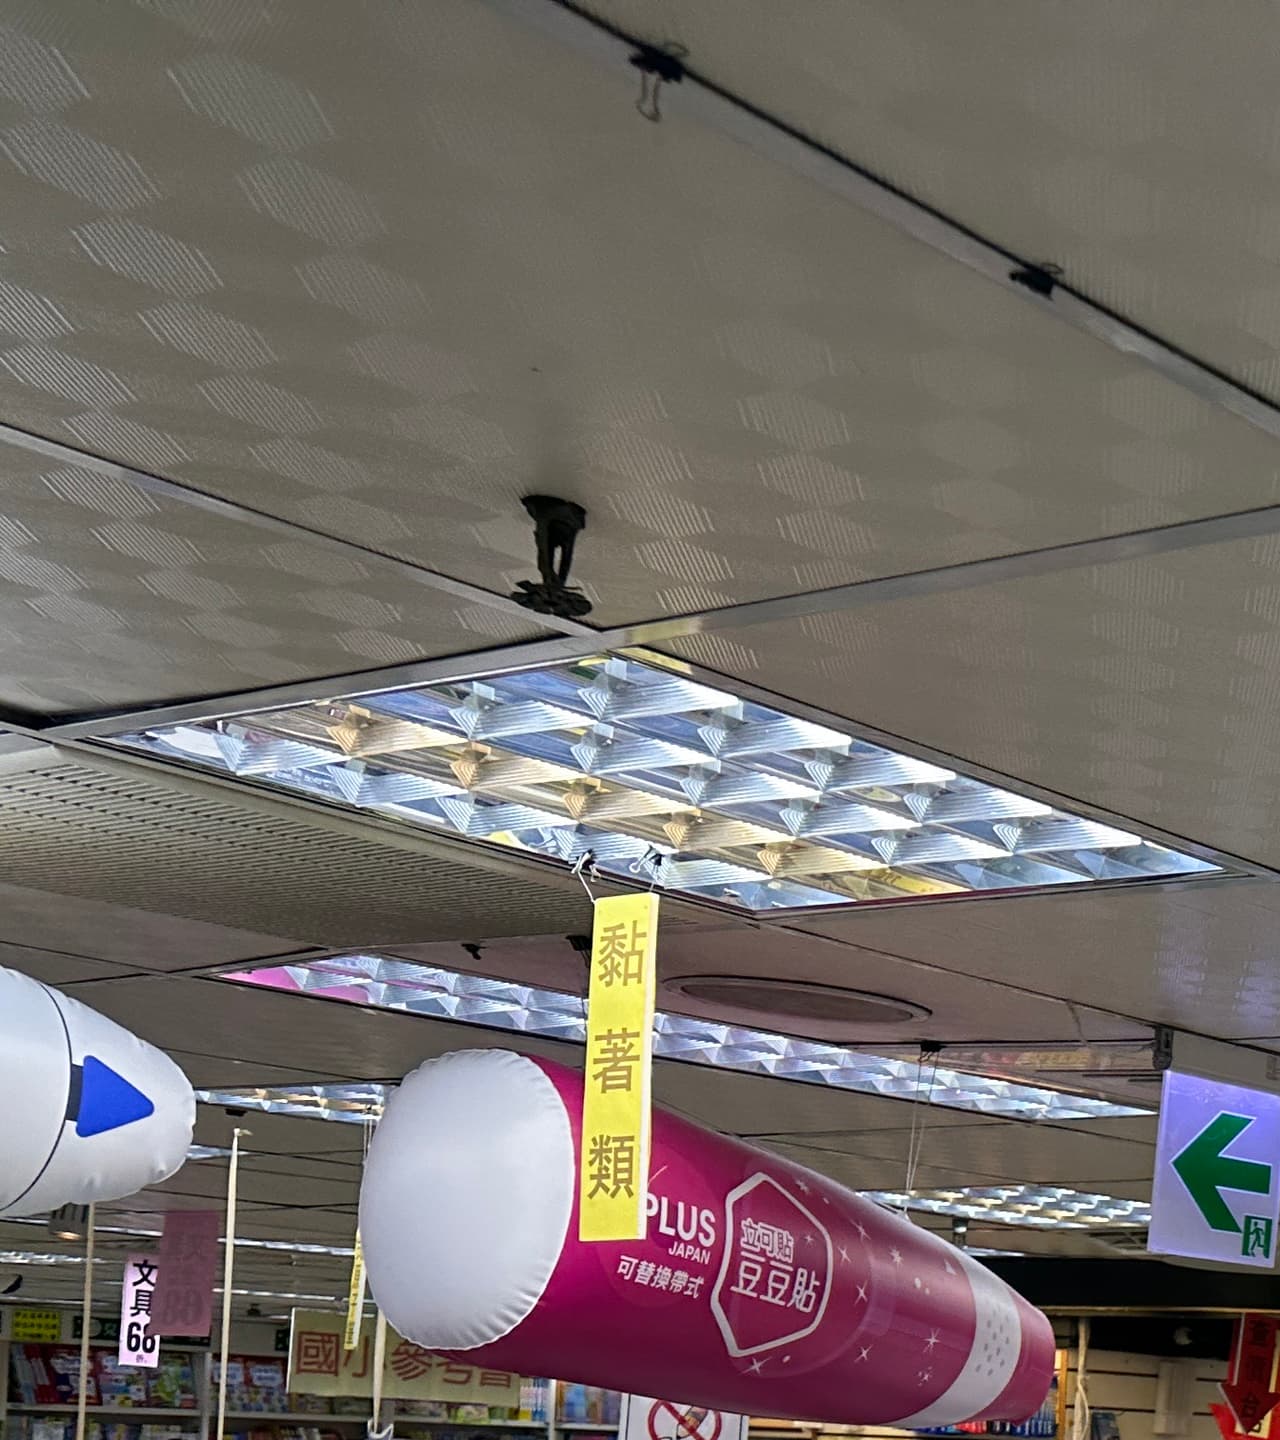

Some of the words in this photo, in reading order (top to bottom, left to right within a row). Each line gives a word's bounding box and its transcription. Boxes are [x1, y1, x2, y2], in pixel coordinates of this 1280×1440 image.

[588, 919, 649, 1200] 黏著類
[646, 1192, 716, 1247] PLUS
[617, 1255, 704, 1299] 可替換帶式
[668, 1241, 711, 1265] JAPAN
[730, 1251, 820, 1313] 豆豆貼
